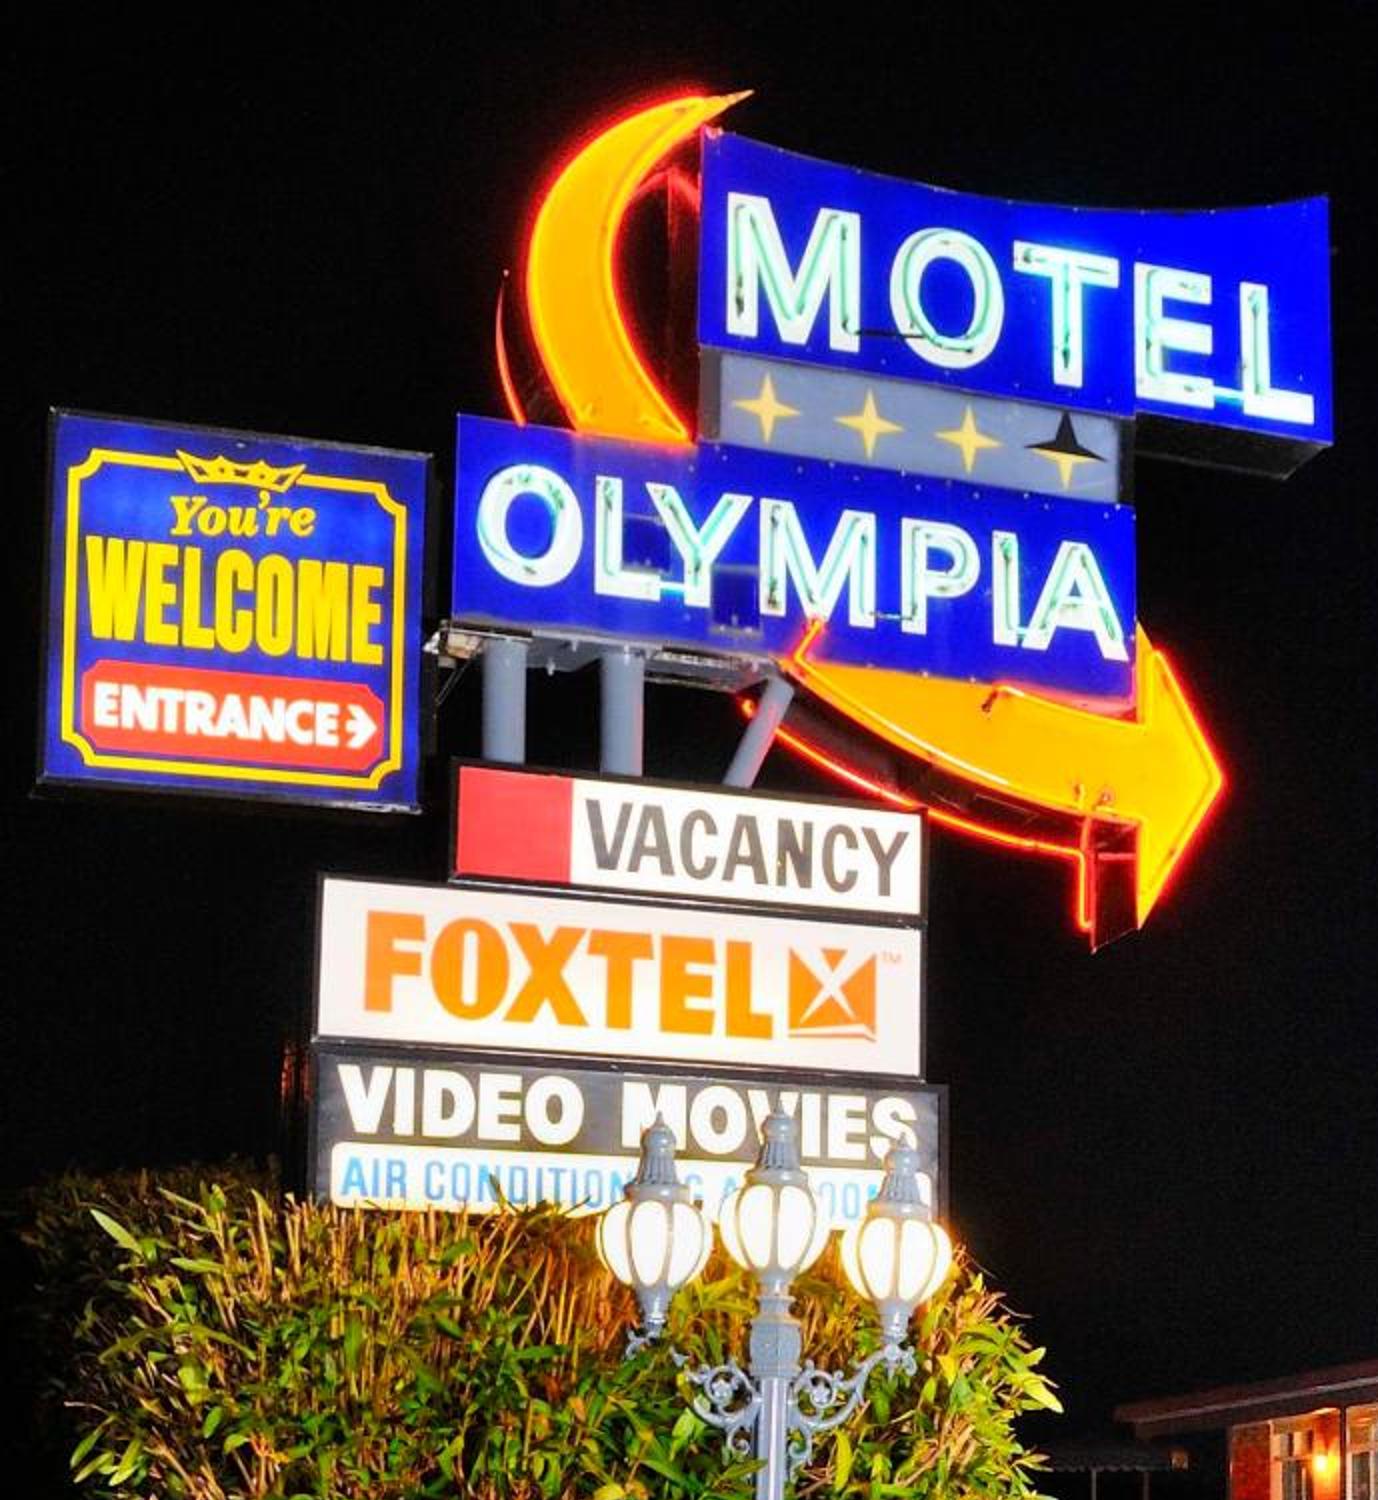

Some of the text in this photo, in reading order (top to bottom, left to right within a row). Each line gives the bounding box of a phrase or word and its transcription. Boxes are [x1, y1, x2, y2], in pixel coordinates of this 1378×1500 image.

[727, 191, 1314, 425] MOTEL
[170, 490, 316, 537] You're
[476, 463, 1128, 661] OLYMPIA
[85, 535, 385, 665] WELCOME
[93, 681, 339, 747] ENTRANCE
[586, 798, 909, 897] VACANCY
[363, 910, 773, 1040] FOXTEL
[337, 1064, 585, 1147] VIDEO
[340, 1155, 407, 1200] AIR
